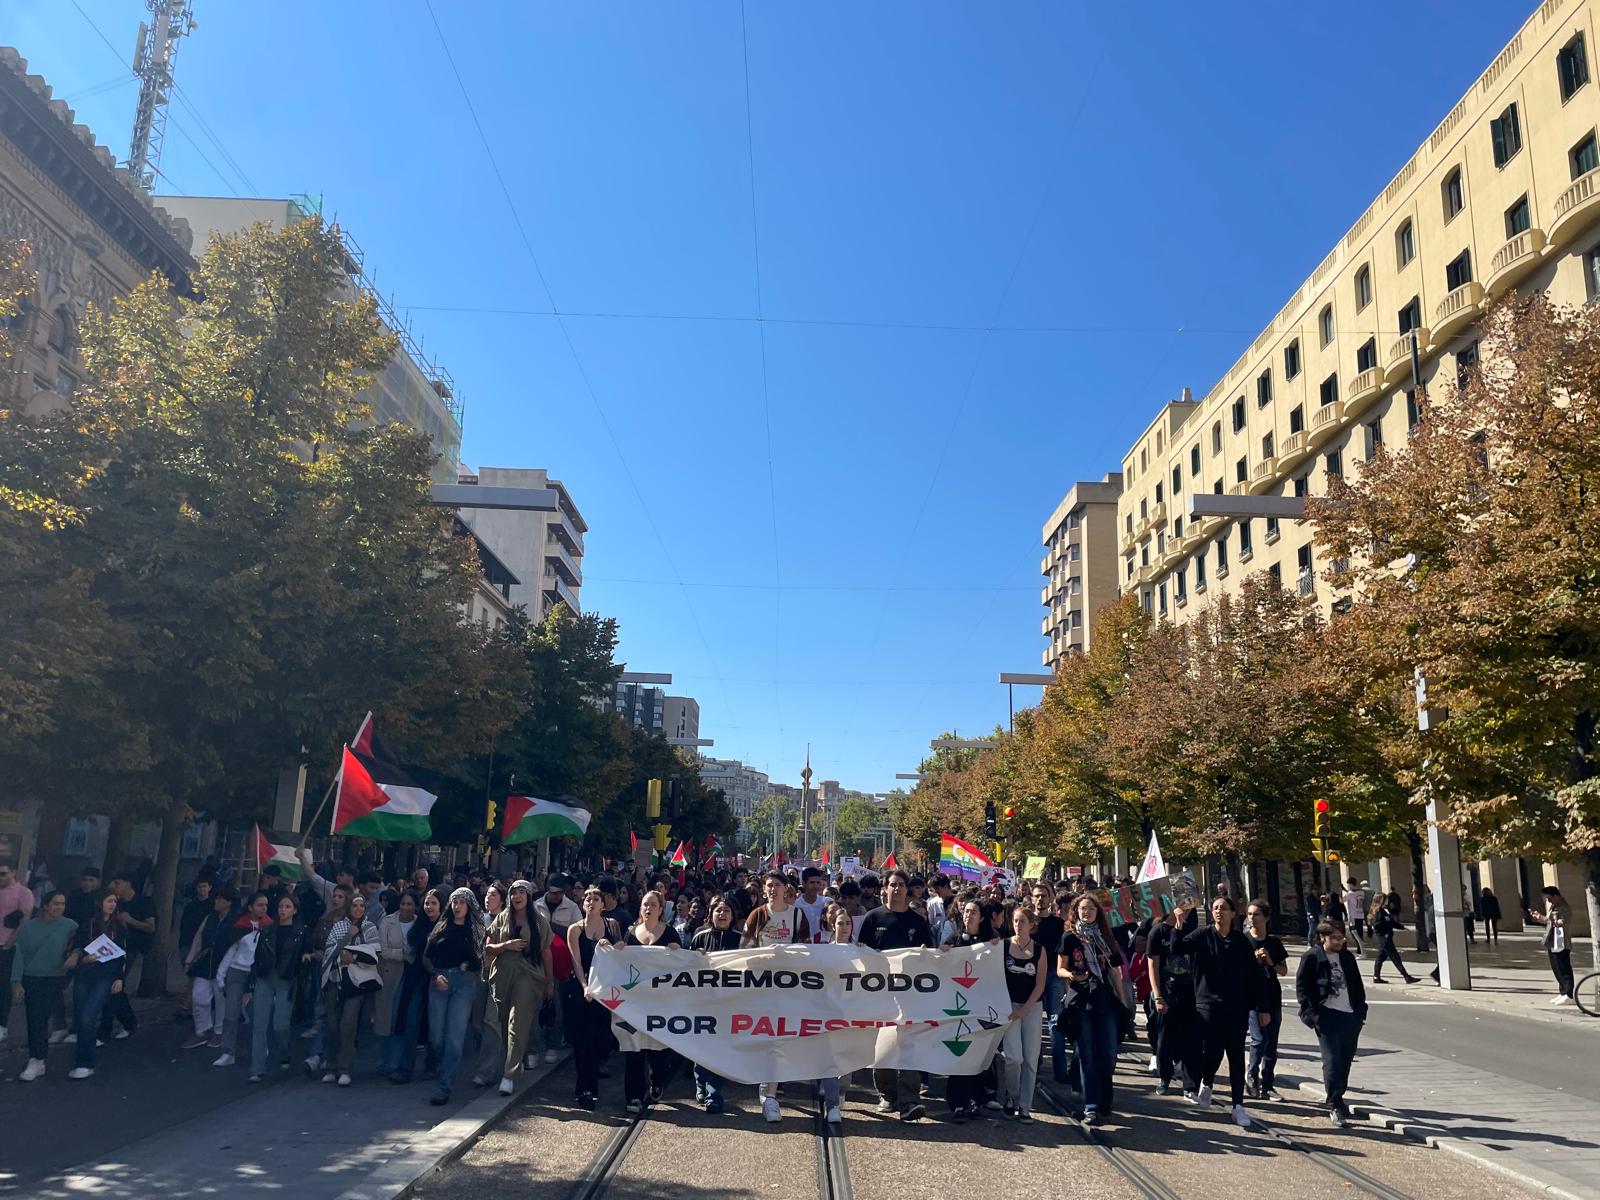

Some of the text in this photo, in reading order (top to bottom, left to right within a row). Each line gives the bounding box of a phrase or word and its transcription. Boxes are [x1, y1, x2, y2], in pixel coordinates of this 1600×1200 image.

[652, 970, 941, 993] PAREMOS TODO
[646, 1015, 717, 1035] POR
